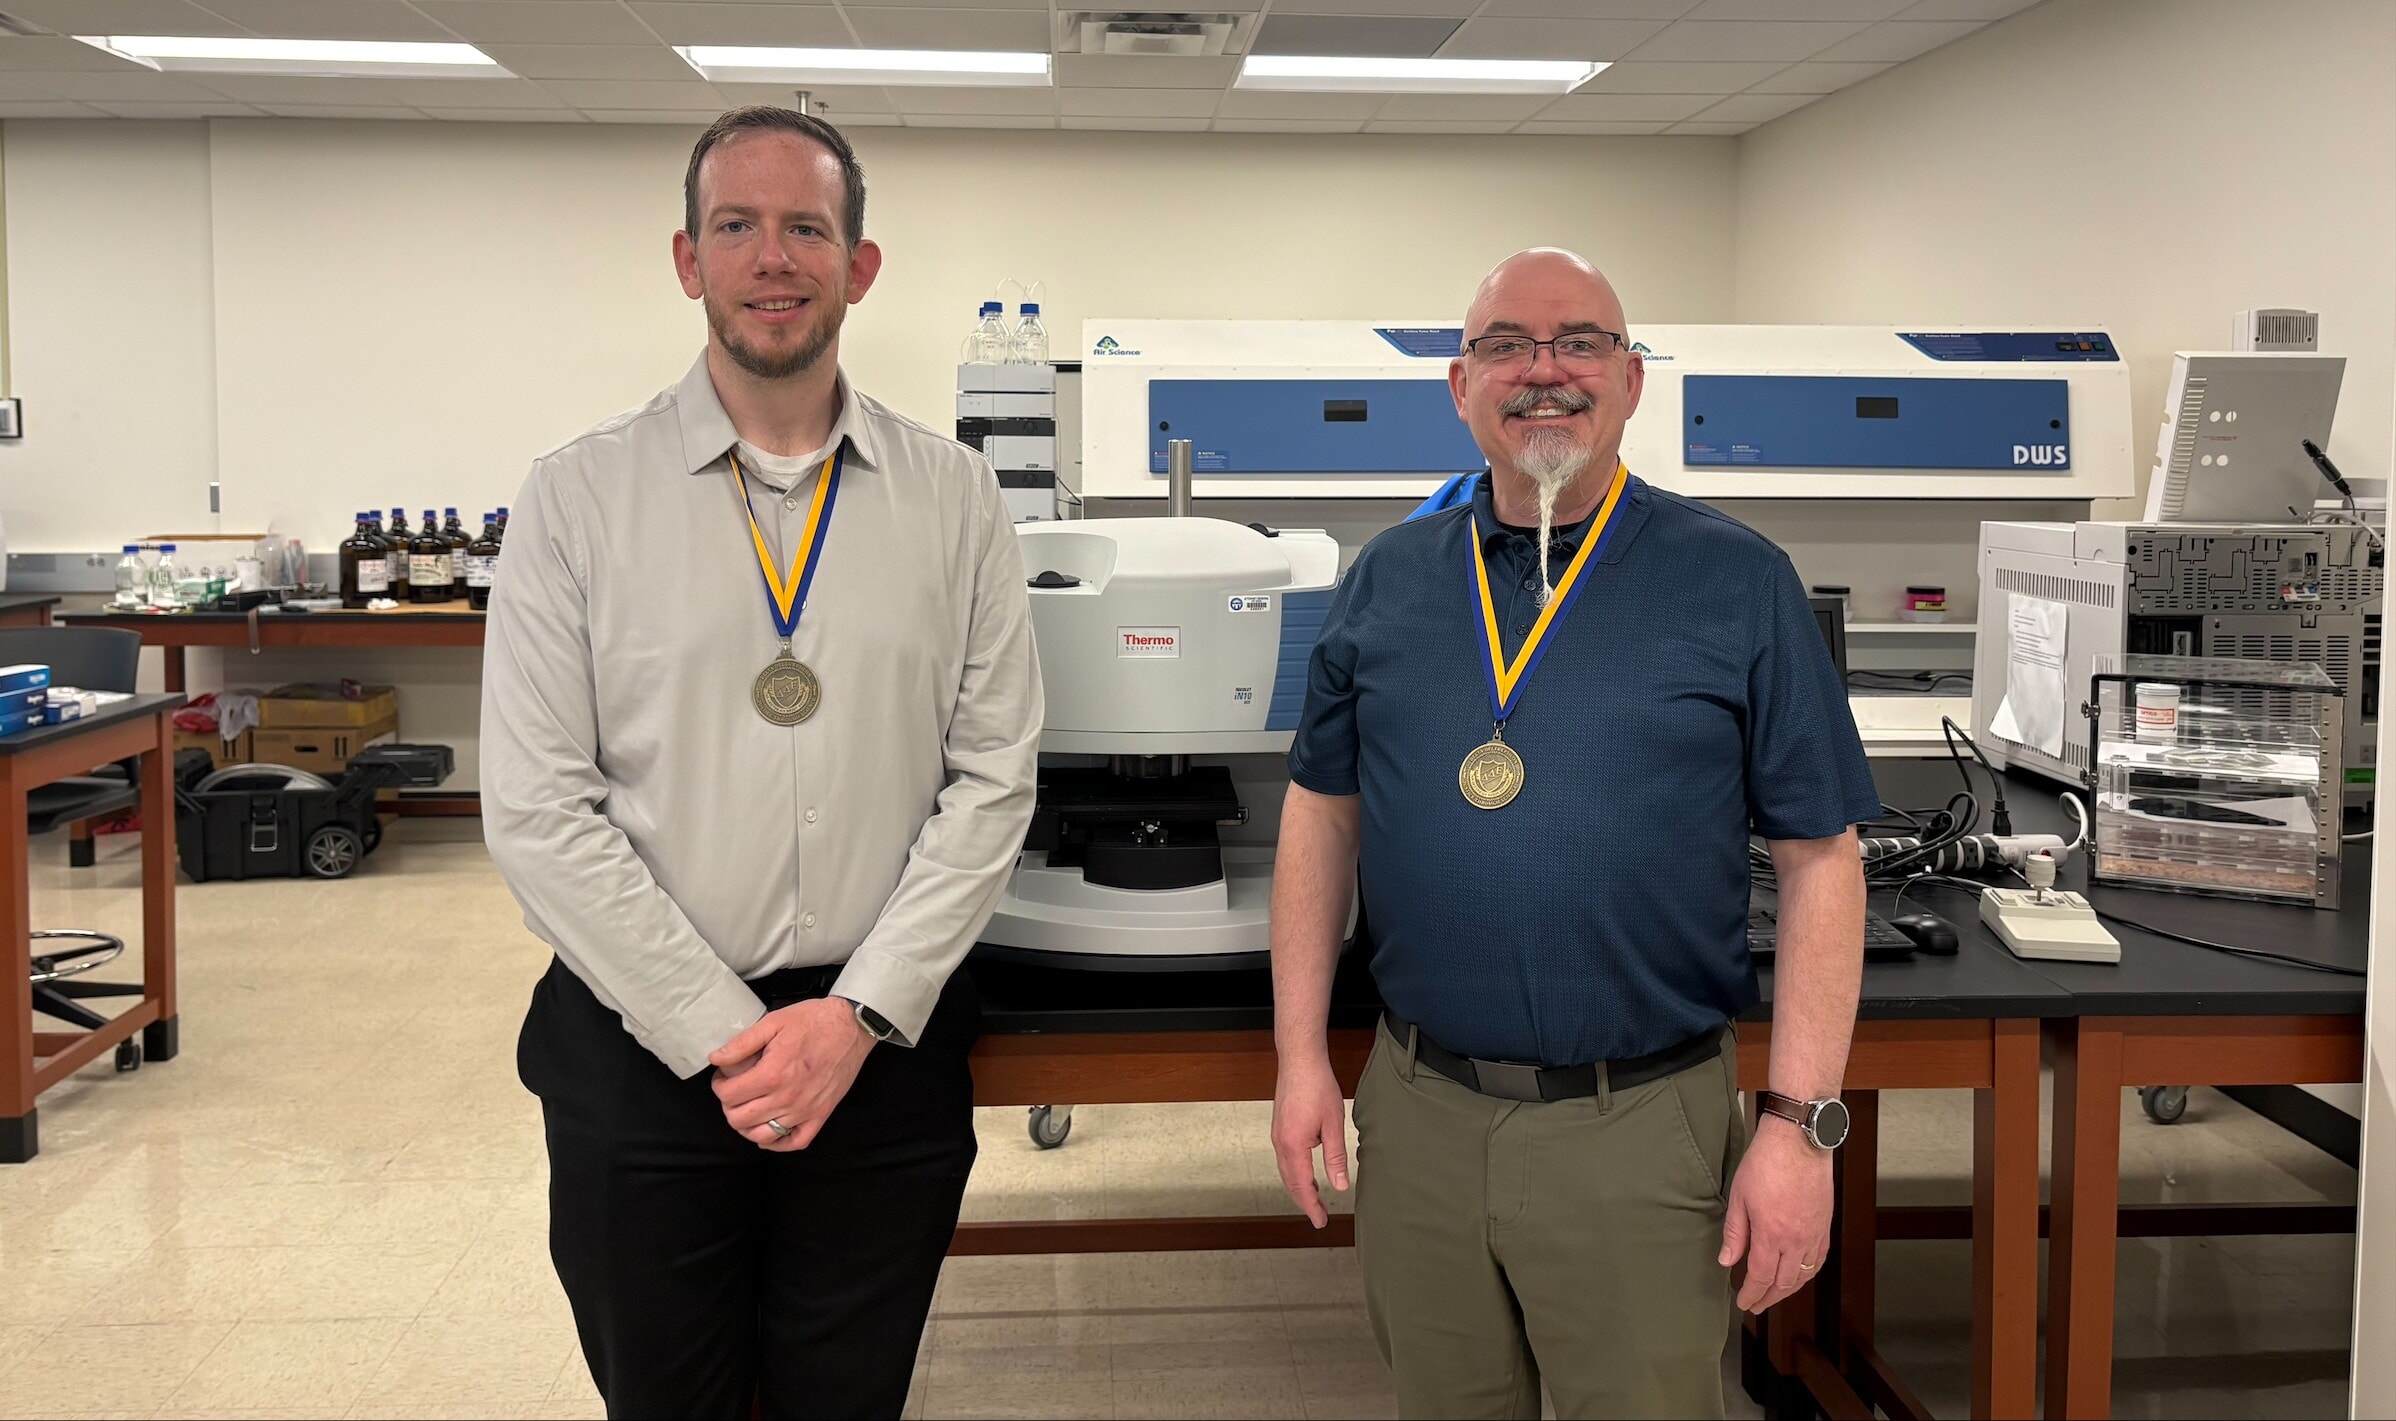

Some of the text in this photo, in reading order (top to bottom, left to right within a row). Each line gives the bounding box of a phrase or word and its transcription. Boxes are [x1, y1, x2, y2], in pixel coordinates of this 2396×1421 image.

[1108, 348, 1141, 356] Science
[2013, 445, 2067, 465] DWS
[1123, 634, 1174, 645] Thermo
